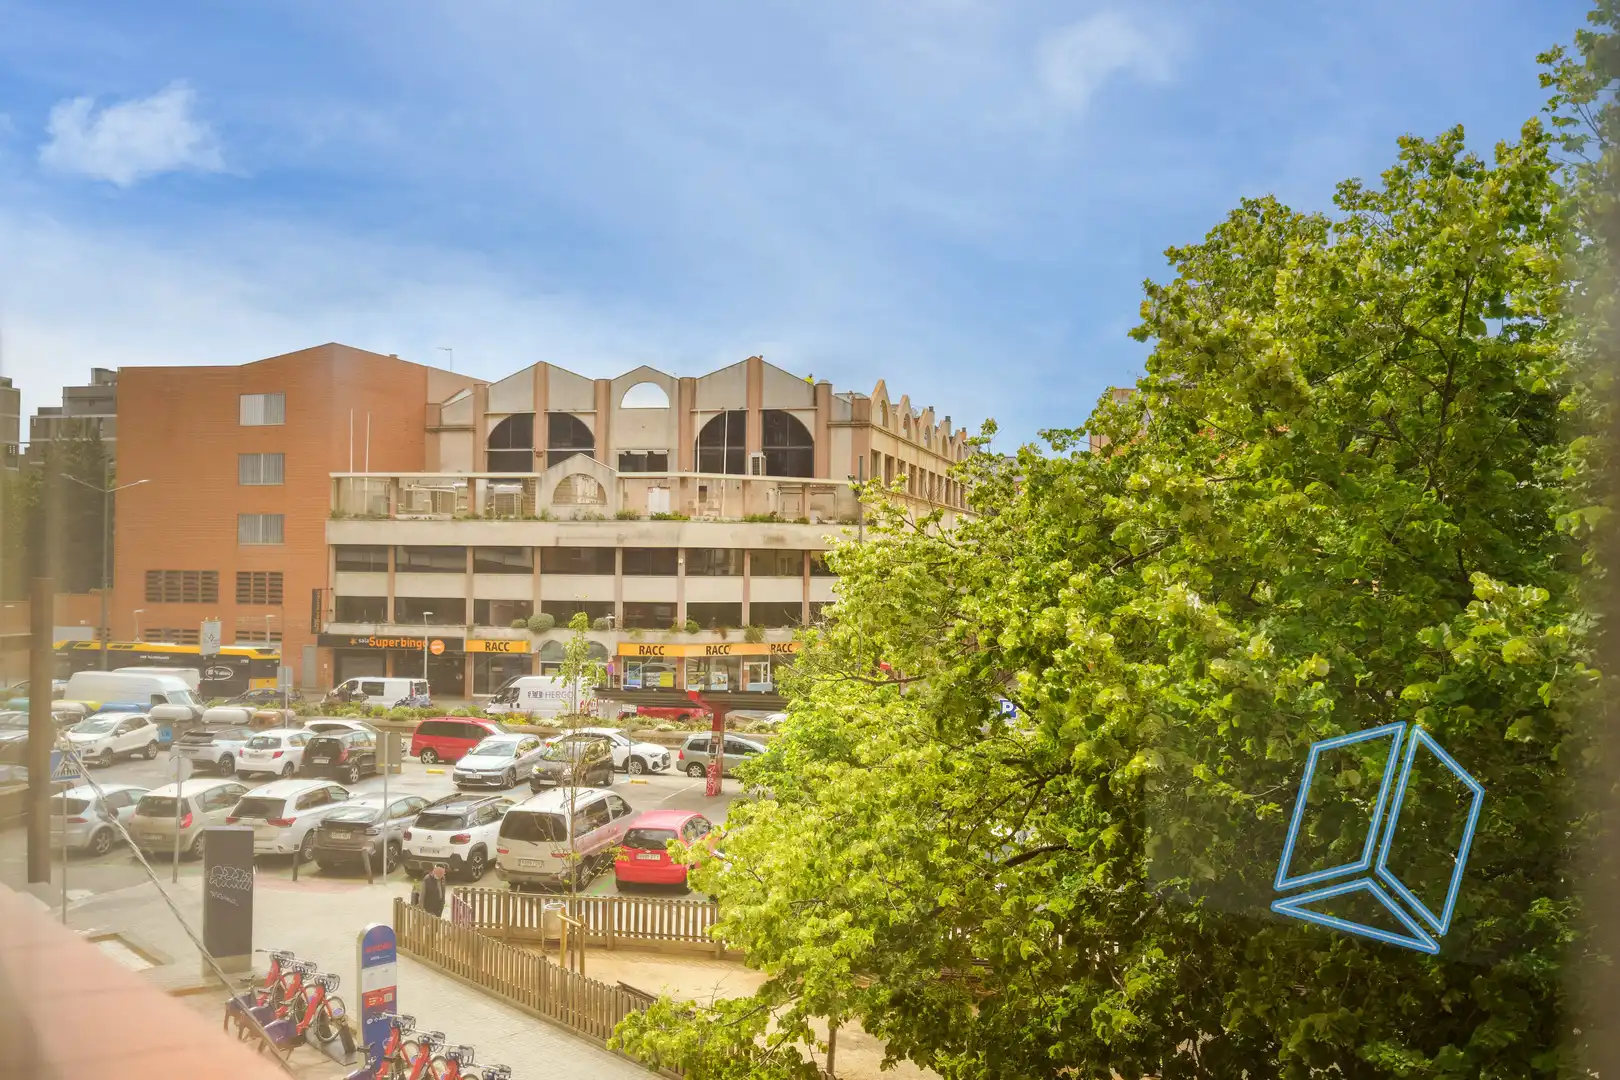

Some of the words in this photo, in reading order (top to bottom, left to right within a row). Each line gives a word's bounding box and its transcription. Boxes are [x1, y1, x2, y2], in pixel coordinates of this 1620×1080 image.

[485, 641, 510, 652] RACC
[639, 645, 665, 655] RACC
[705, 645, 730, 655] RACC
[770, 643, 793, 653] RACC
[1002, 701, 1014, 714] P
